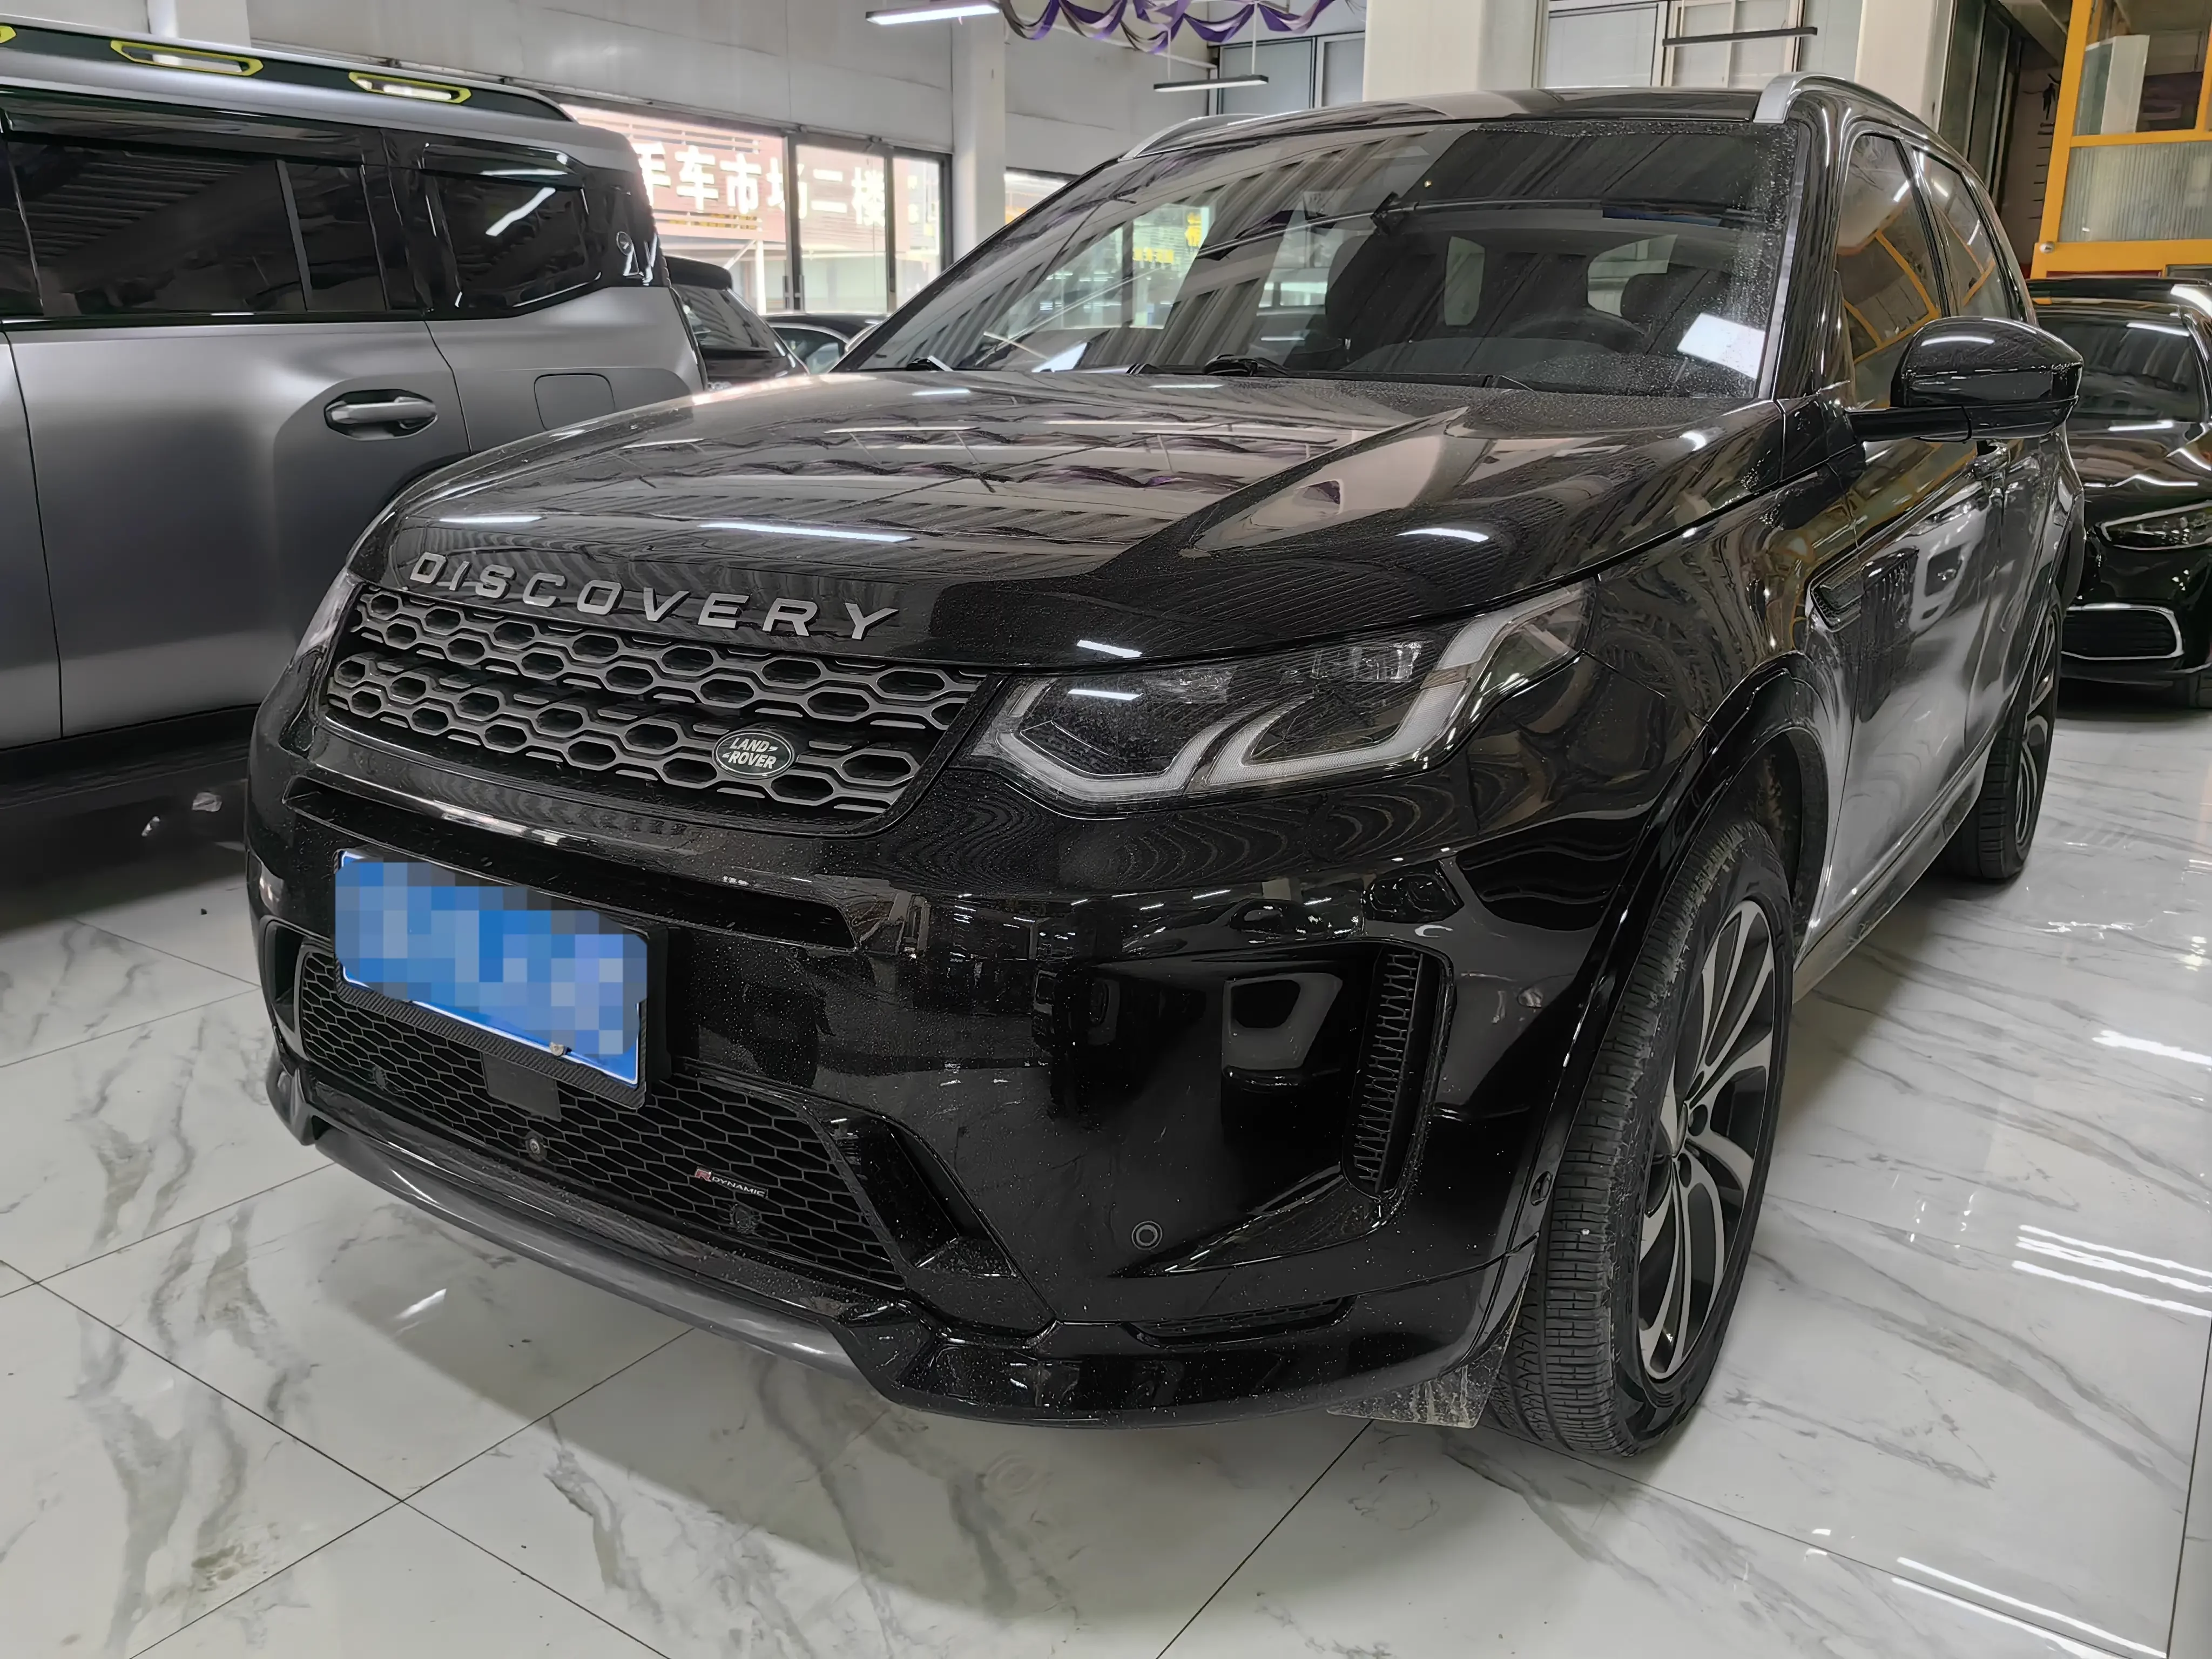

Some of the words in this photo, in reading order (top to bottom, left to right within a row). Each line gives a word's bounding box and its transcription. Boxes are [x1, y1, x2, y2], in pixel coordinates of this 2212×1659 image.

[410, 551, 899, 640] DISCOVERY
[730, 737, 770, 753] LAND
[729, 751, 777, 768] ROVER
[712, 1176, 765, 1197] DYNAMIC
